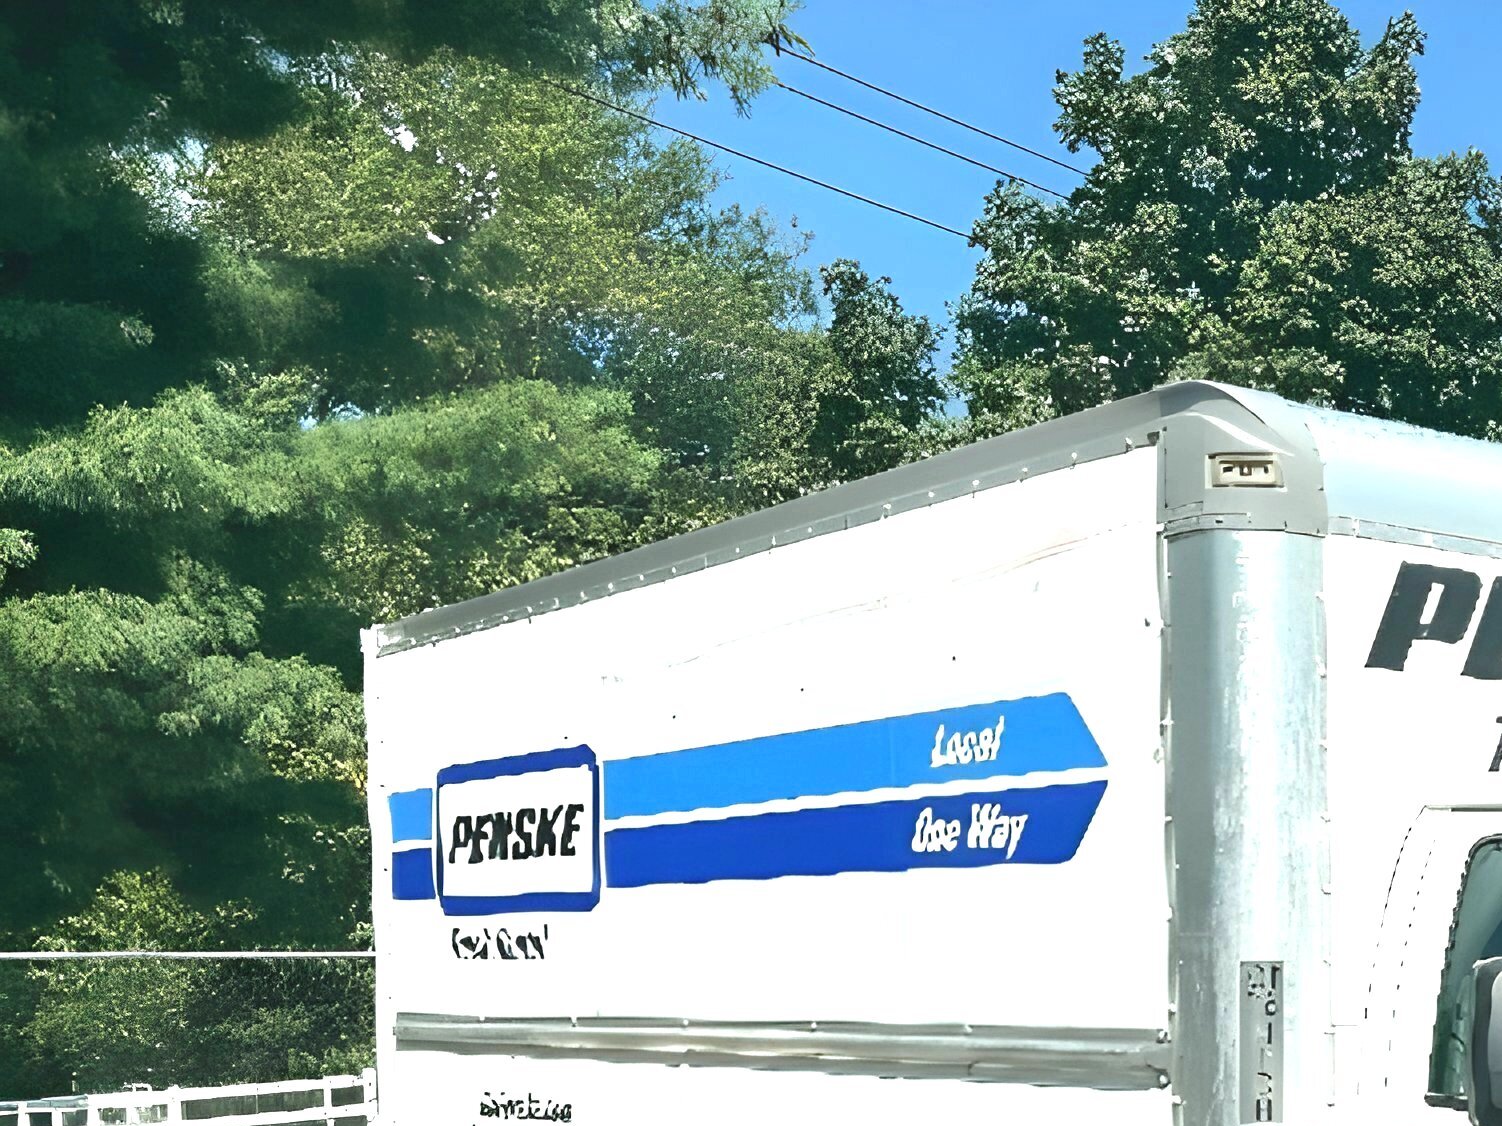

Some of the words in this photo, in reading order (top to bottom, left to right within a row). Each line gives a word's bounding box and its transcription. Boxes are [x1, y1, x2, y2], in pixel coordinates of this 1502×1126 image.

[449, 804, 584, 864] PENSKE
[912, 808, 960, 852] One
[968, 804, 1027, 858] Way
